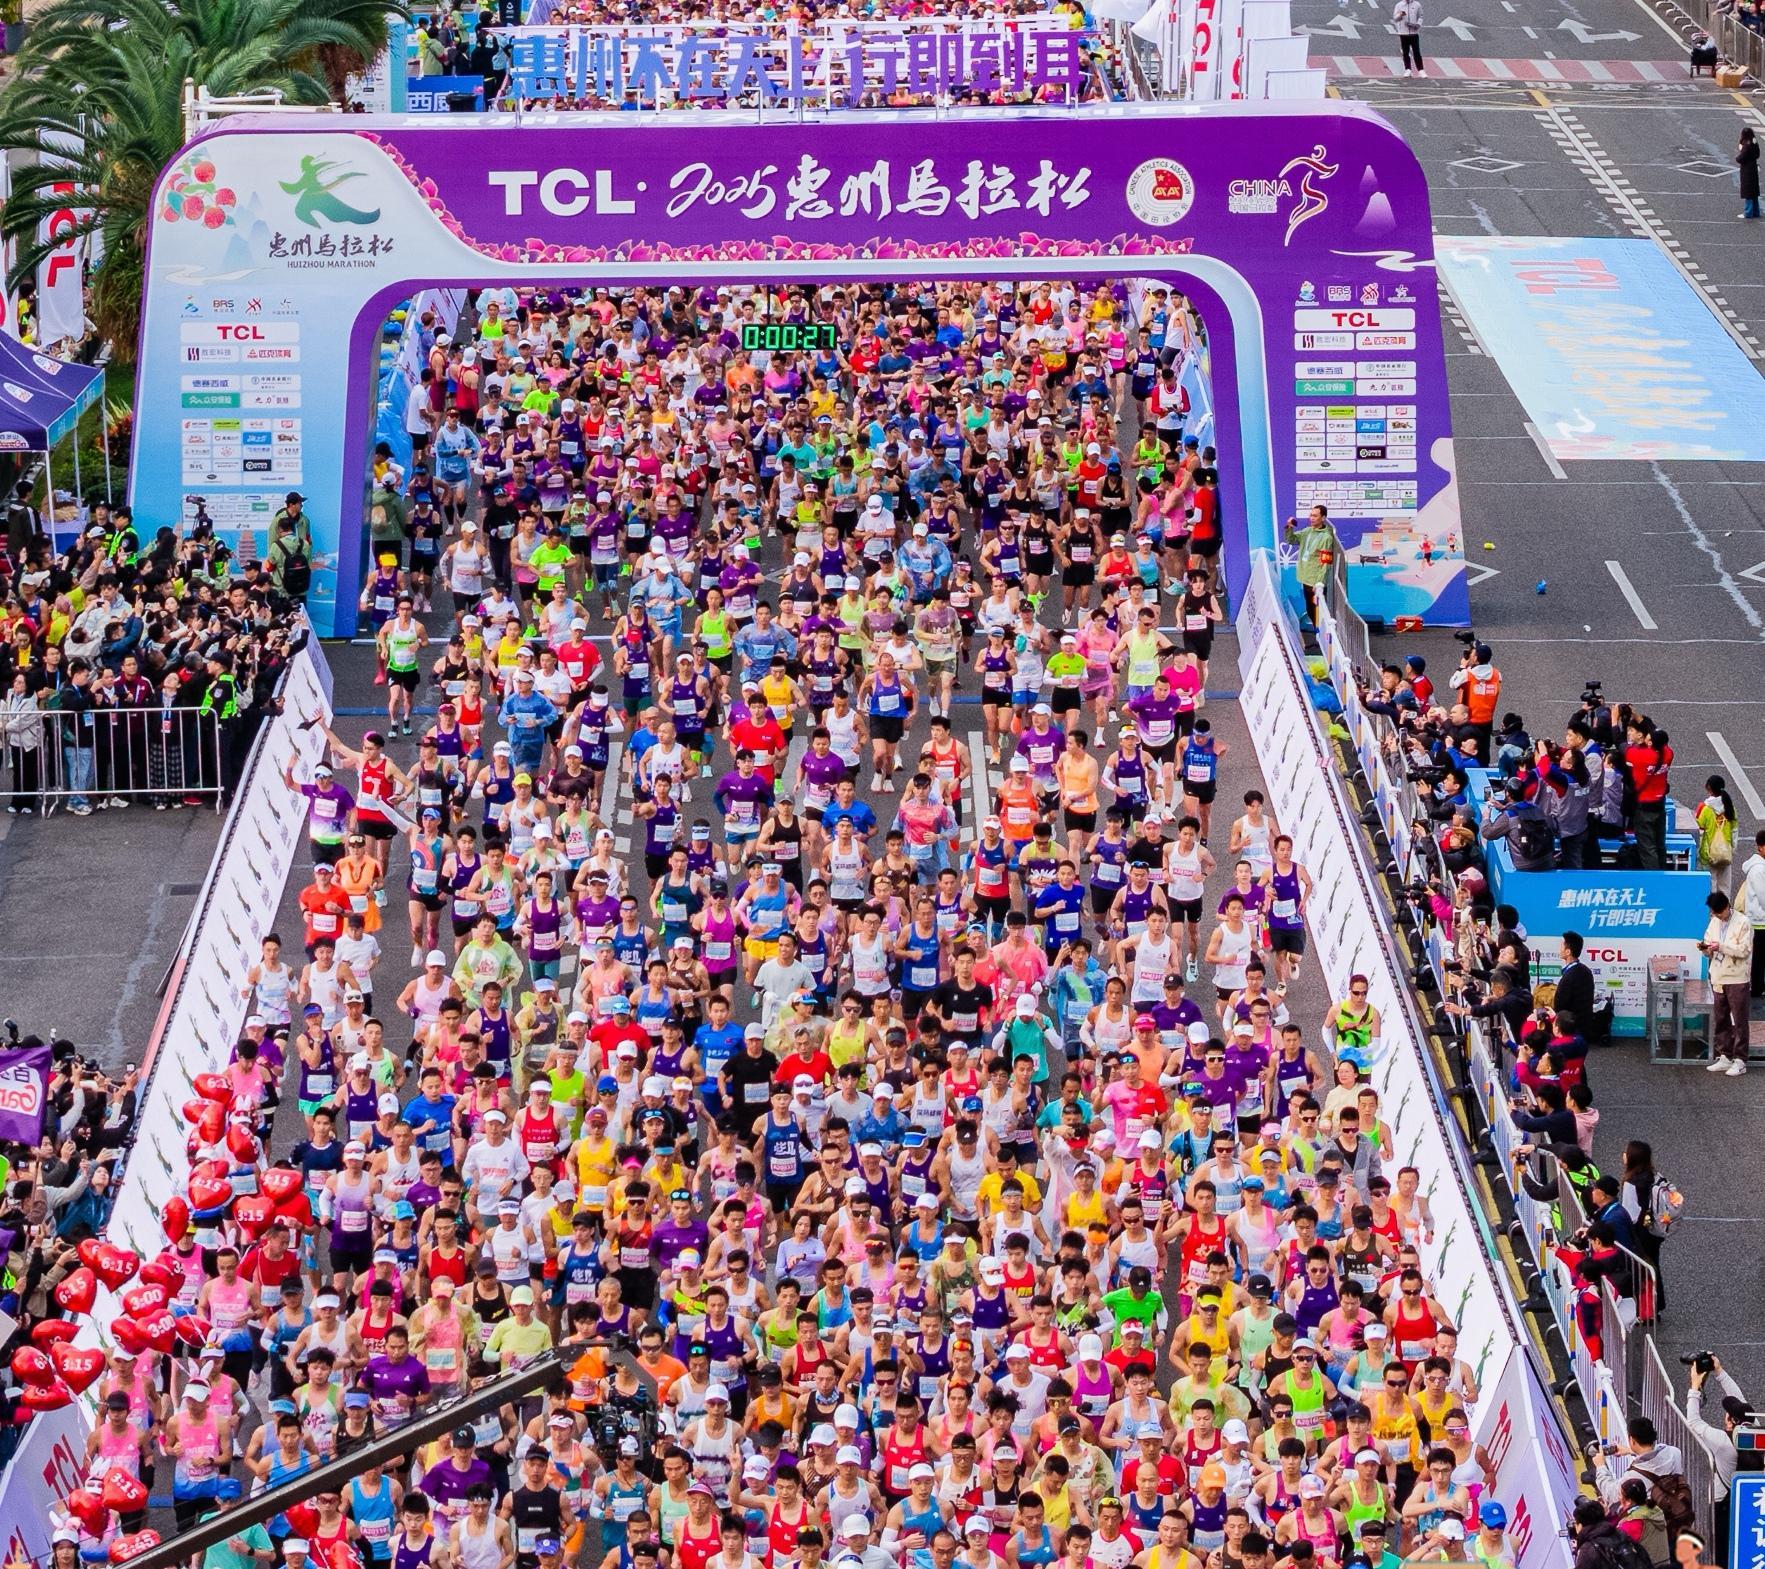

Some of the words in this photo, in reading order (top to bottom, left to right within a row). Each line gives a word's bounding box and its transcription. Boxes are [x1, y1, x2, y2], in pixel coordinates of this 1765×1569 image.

[1229, 179, 1292, 197] CHINA
[287, 259, 325, 269] HUIZHOU
[327, 259, 376, 268] MARATHON
[212, 299, 235, 308] BRS
[1331, 312, 1380, 328] TCL
[216, 324, 266, 341] TCL
[744, 326, 835, 349] 0:00:27
[1558, 888, 1647, 908] 惠州不在天上
[1588, 908, 1663, 930] 行即到耳
[1586, 949, 1629, 963] TCL
[237, 1209, 264, 1222] 3:15
[101, 1258, 134, 1275] 6:15
[58, 1277, 87, 1305] 6:15
[130, 1288, 163, 1311] 3:00
[147, 1315, 176, 1338] 3:00
[62, 1358, 93, 1372] 3:15
[110, 1472, 140, 1500] 3:15
[118, 1534, 156, 1561] 2:45
